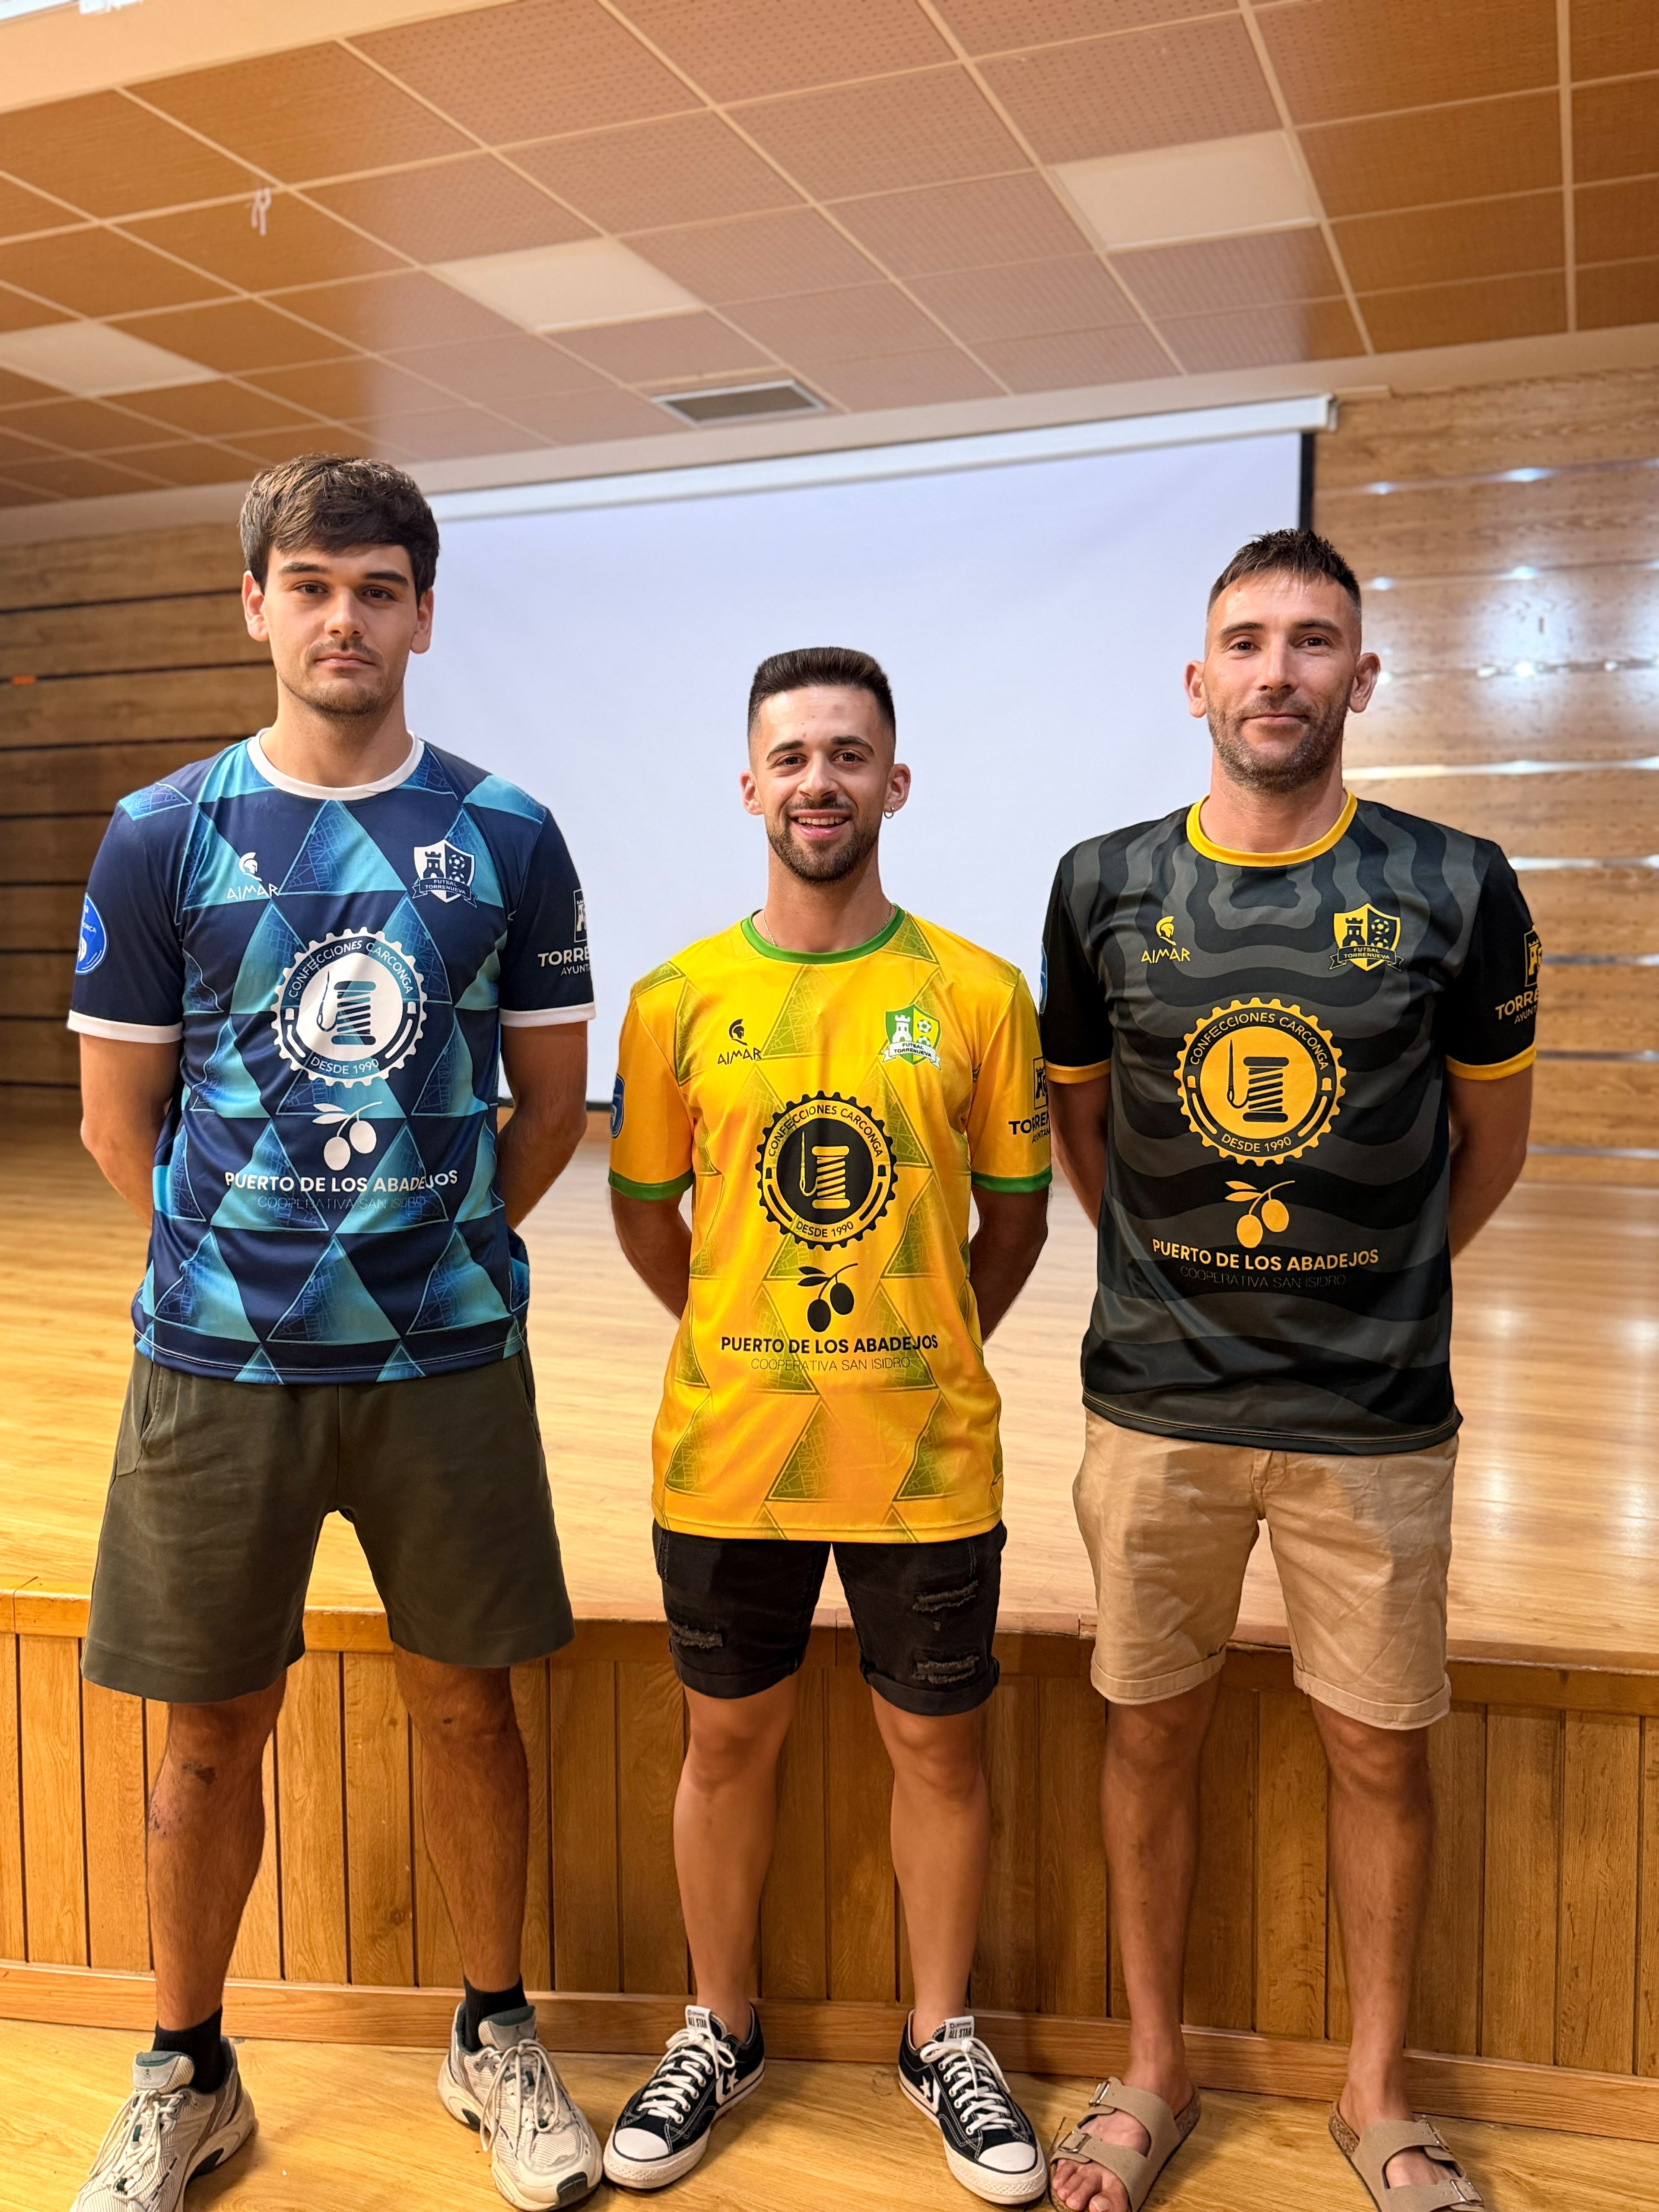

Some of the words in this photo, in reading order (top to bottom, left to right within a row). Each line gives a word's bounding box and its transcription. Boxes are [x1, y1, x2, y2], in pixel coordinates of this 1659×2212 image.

[227, 883, 280, 901] AIMAR
[425, 885, 466, 895] TORRENUEVA
[1141, 947, 1191, 964] AIMAR
[289, 940, 363, 998] CONFECCIONES
[365, 942, 413, 994] CARCONGA
[561, 963, 590, 976] AYUNT
[1190, 1012, 1275, 1065] CONFECCIONES
[1279, 1017, 1329, 1070] CARCONGA
[717, 1047, 762, 1065] AIMAR
[893, 1049, 932, 1058] TORRENUEVA
[310, 1056, 349, 1074] DESDE
[353, 1058, 379, 1074] 1990
[769, 1104, 837, 1157] CONFECCIONES
[840, 1108, 883, 1157] CARCONGA
[1221, 1133, 1261, 1153] DESDE
[1264, 1137, 1291, 1152] 1990
[225, 1172, 295, 1192] PUERTO
[300, 1177, 326, 1192] DE
[331, 1177, 368, 1192] LOS
[373, 1170, 458, 1192] ABADEJOS
[257, 1196, 355, 1209] COOPERATIVA
[359, 1198, 387, 1209] SAN
[796, 1220, 828, 1238] DESDE
[831, 1221, 854, 1236] 1990
[1152, 1239, 1211, 1264] PUERTO
[1216, 1252, 1239, 1269] DE
[1245, 1255, 1282, 1271] LOS
[1286, 1249, 1379, 1271] ABADEJOS
[1180, 1266, 1268, 1287] COOPERATIVA
[1273, 1277, 1301, 1288] SAN
[1306, 1274, 1346, 1287] ISIDRO
[721, 1337, 784, 1352] PUERTO
[788, 1339, 810, 1354] DE
[815, 1339, 849, 1354] LOS
[853, 1334, 938, 1353] ABADEJOS
[751, 1358, 838, 1371] COOPERATIVA
[842, 1358, 867, 1370] SAN
[871, 1357, 910, 1370] ISIDRO
